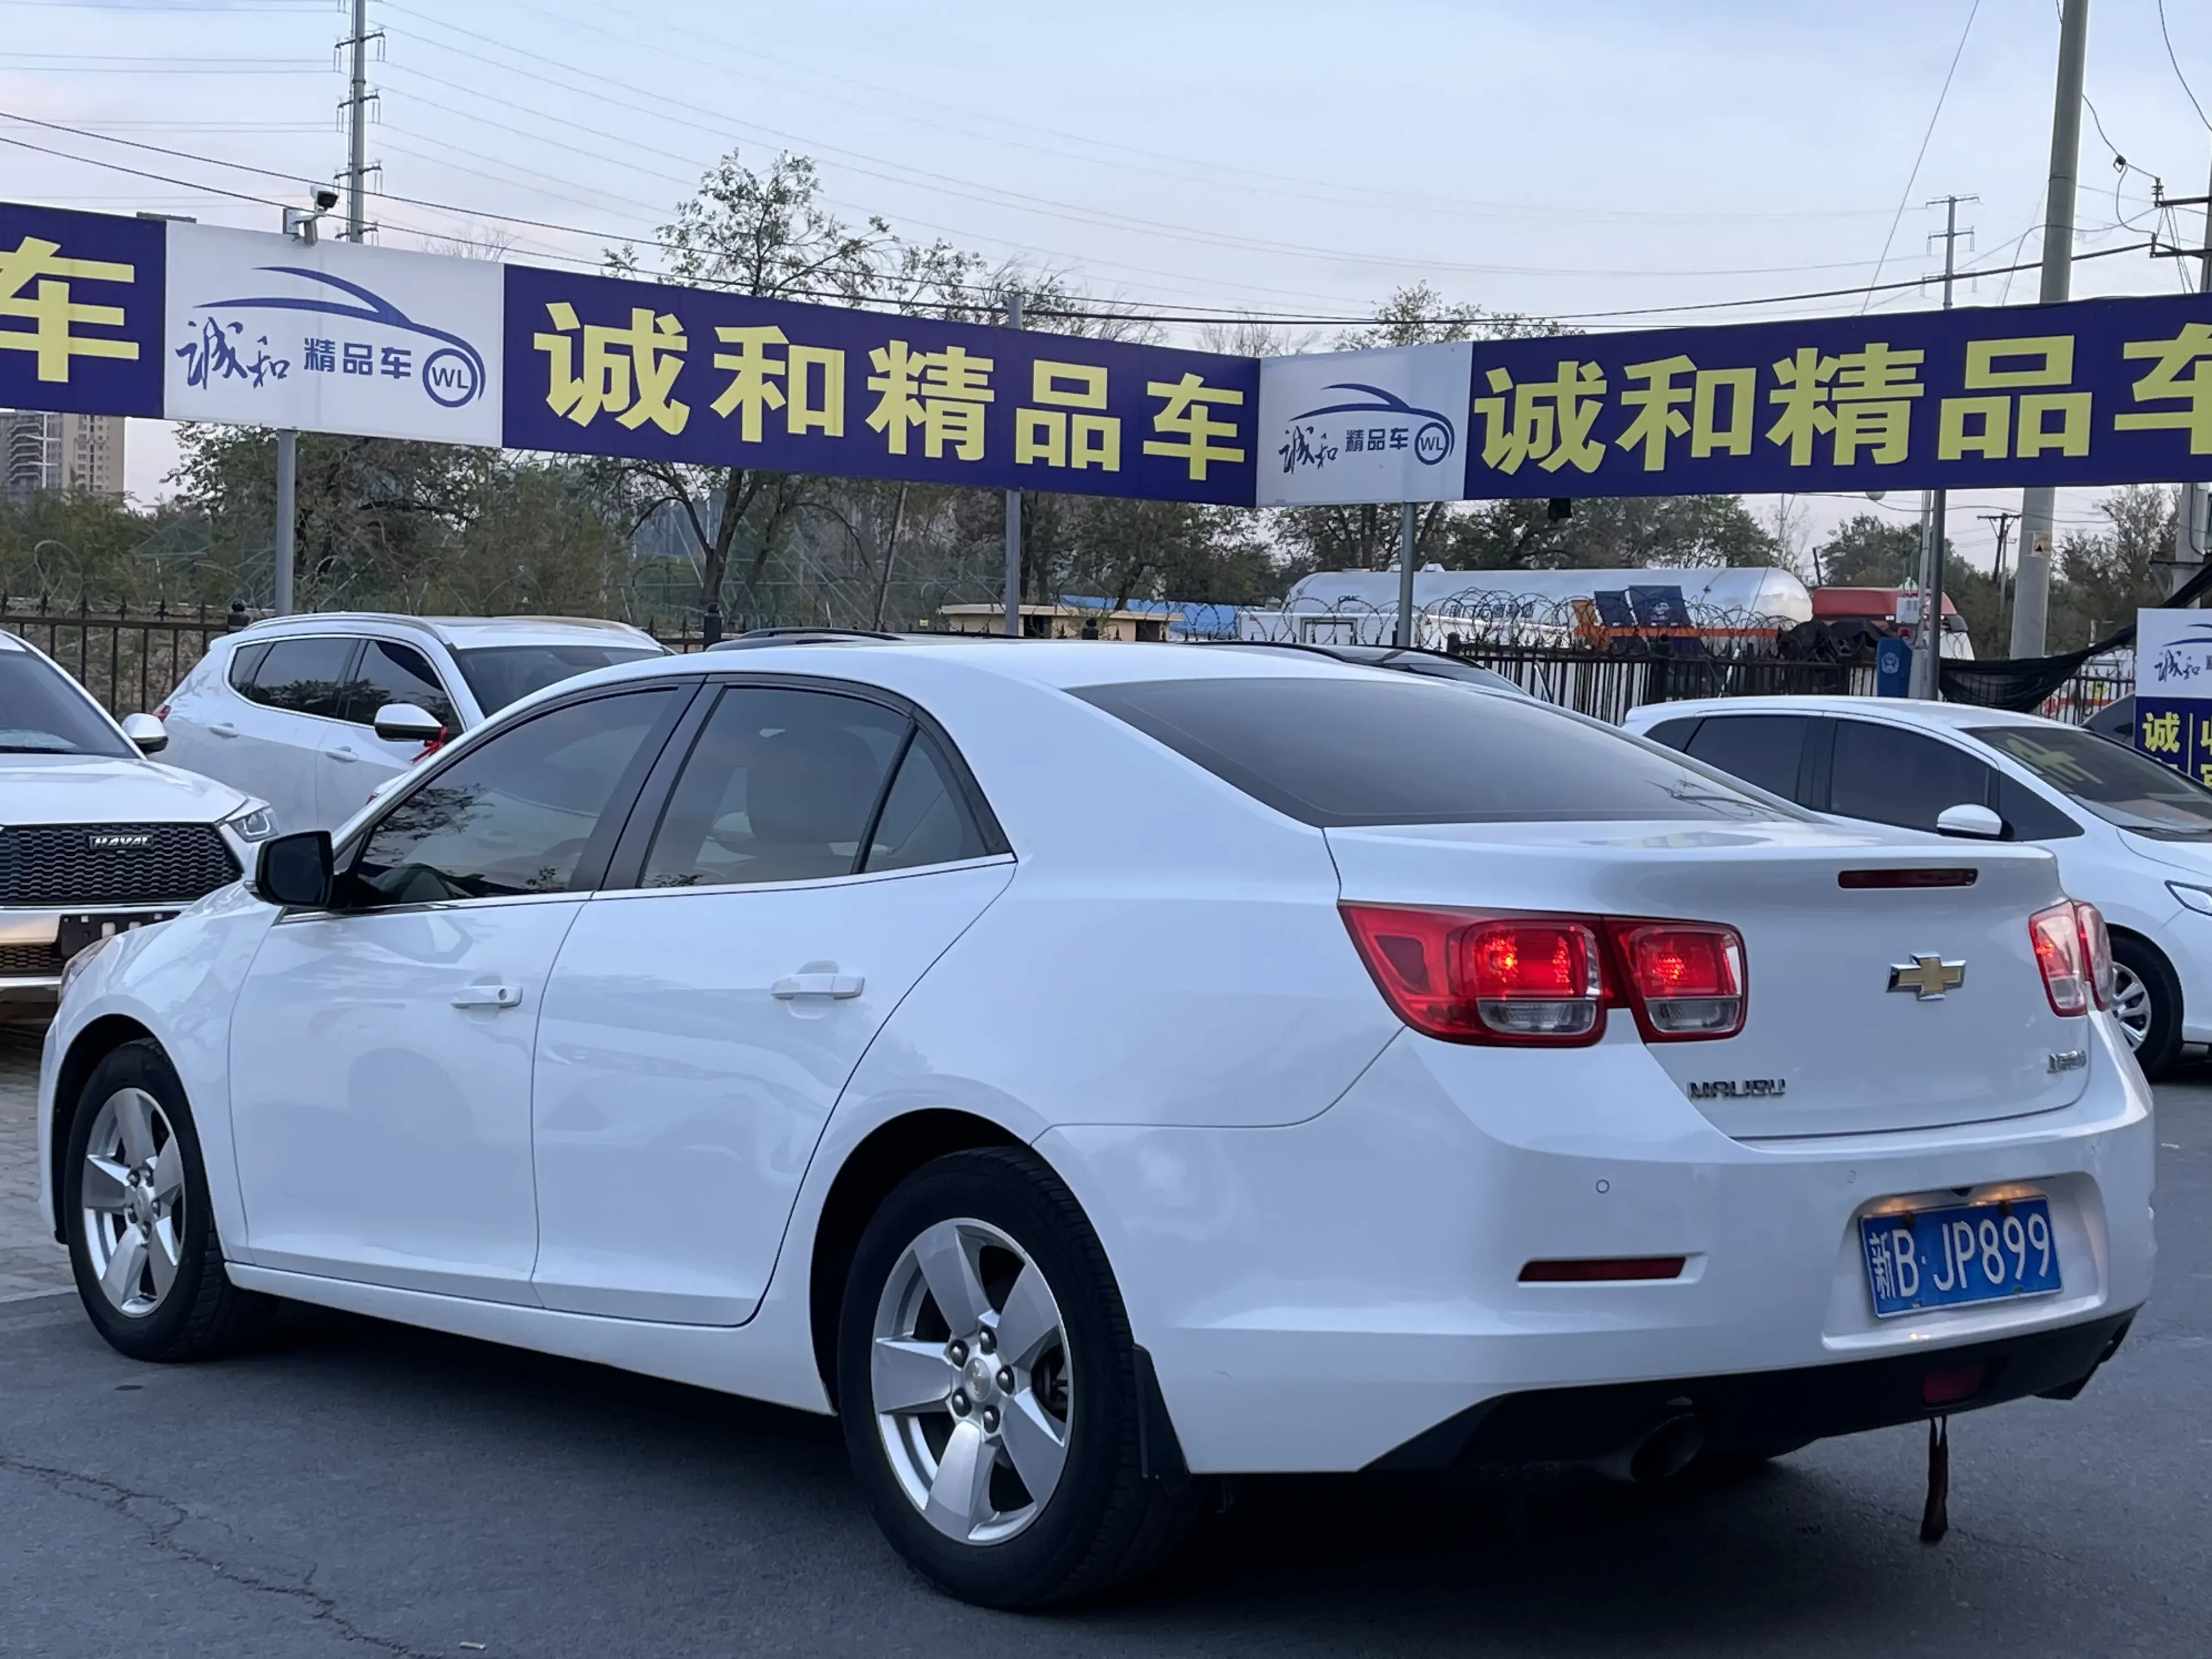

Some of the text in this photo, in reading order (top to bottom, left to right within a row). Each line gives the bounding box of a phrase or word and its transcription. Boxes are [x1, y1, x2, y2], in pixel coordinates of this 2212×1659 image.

[303, 337, 412, 380] 精品车
[432, 366, 470, 391] WL
[533, 302, 1245, 481] 诚和精品车
[1474, 322, 2212, 475] 诚和精品车
[1345, 427, 1409, 453] 精品车
[1420, 435, 1444, 452] WL
